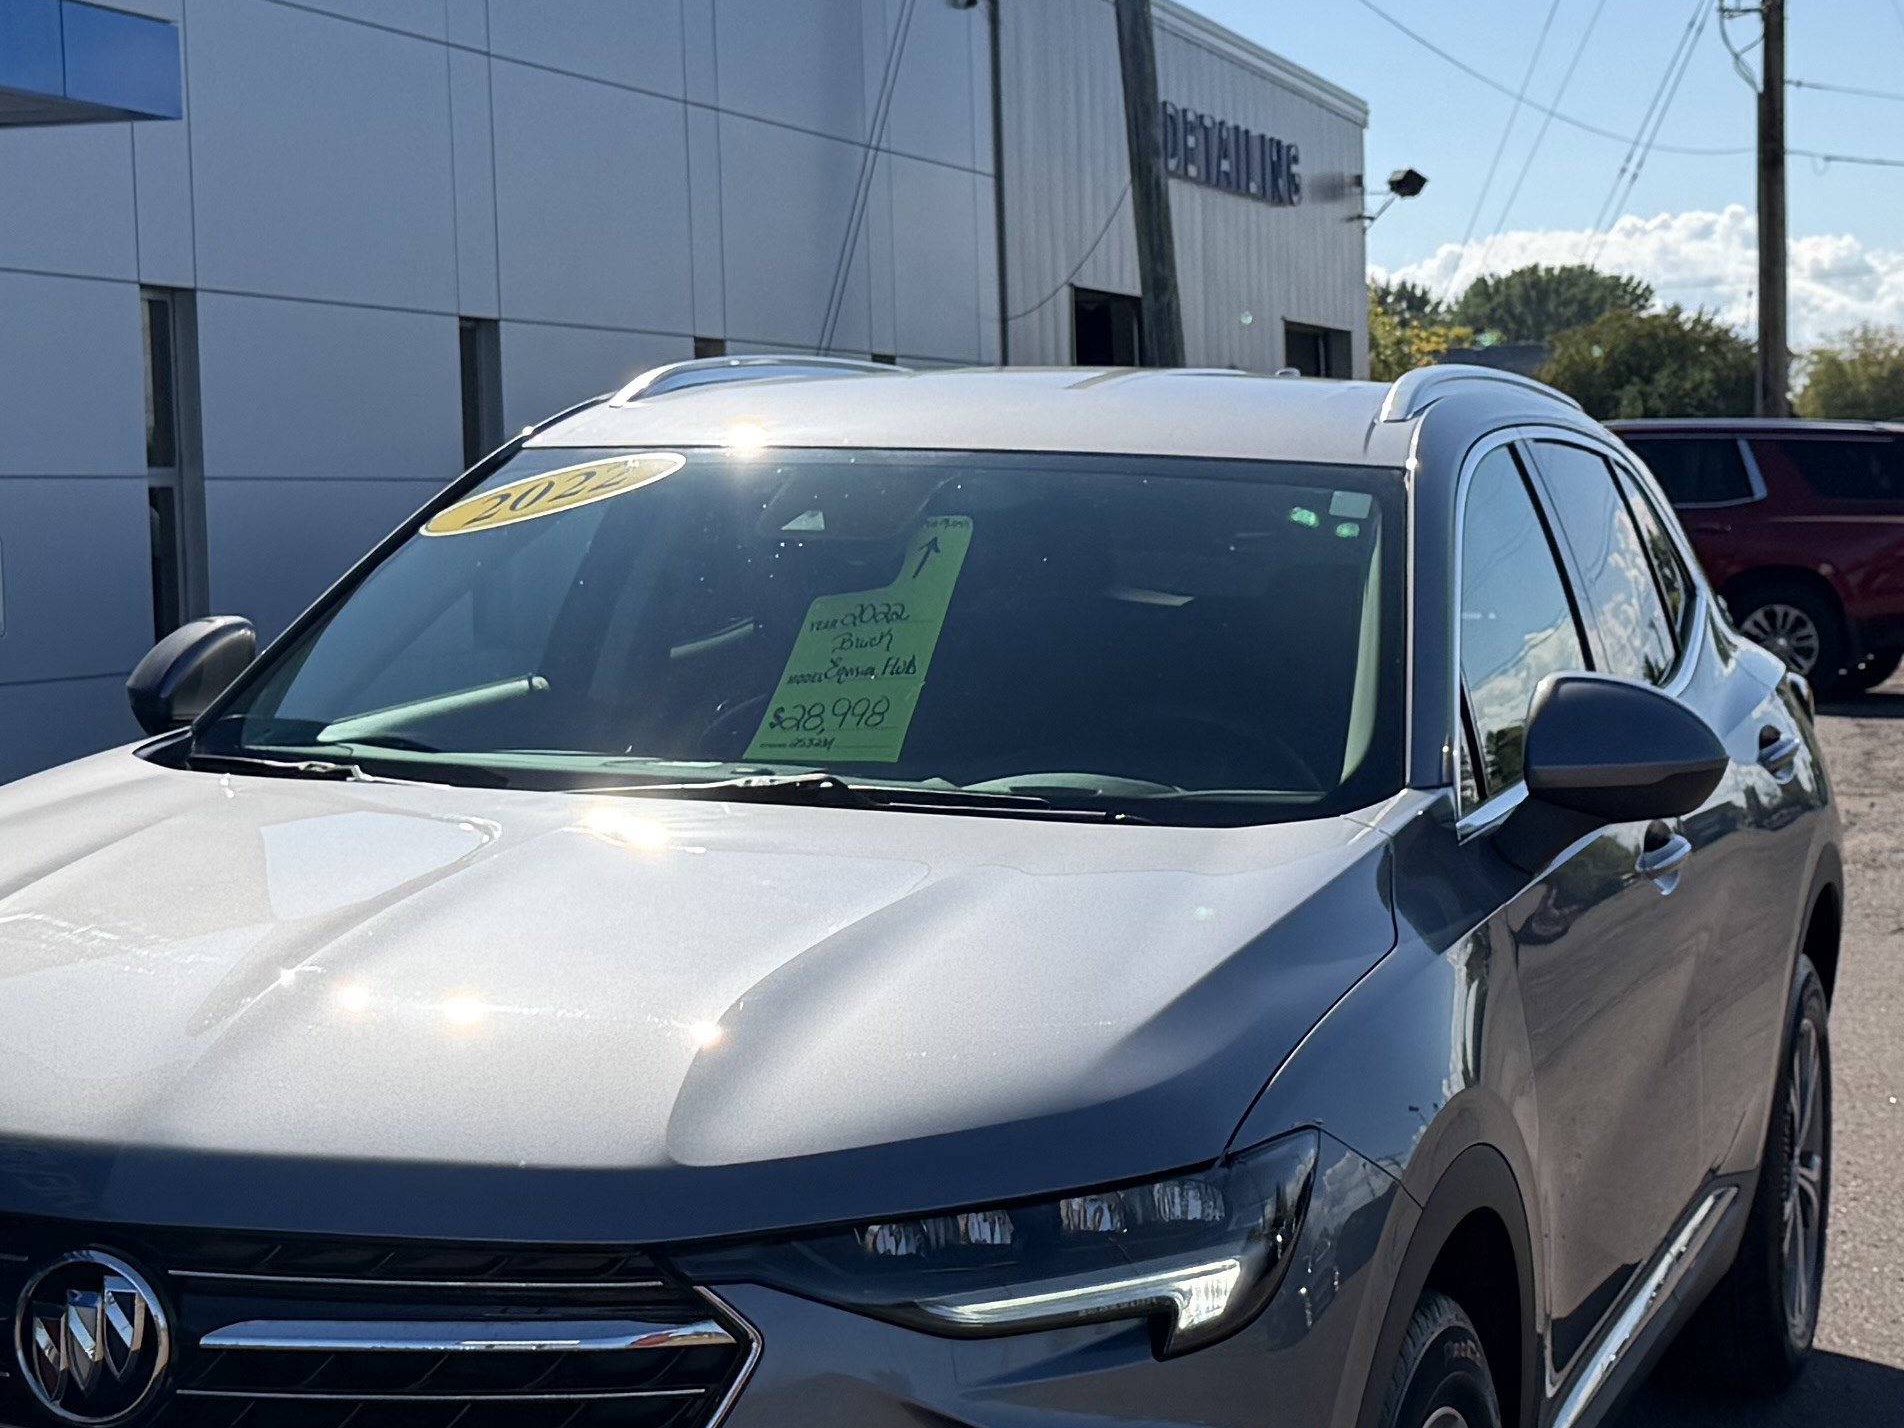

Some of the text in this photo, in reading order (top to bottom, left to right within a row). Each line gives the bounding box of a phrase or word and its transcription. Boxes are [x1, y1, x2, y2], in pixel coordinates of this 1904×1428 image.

[1161, 99, 1303, 206] DETAILING
[461, 462, 630, 528] 2022
[841, 602, 910, 627] 2022
[769, 695, 890, 735] $28,998
